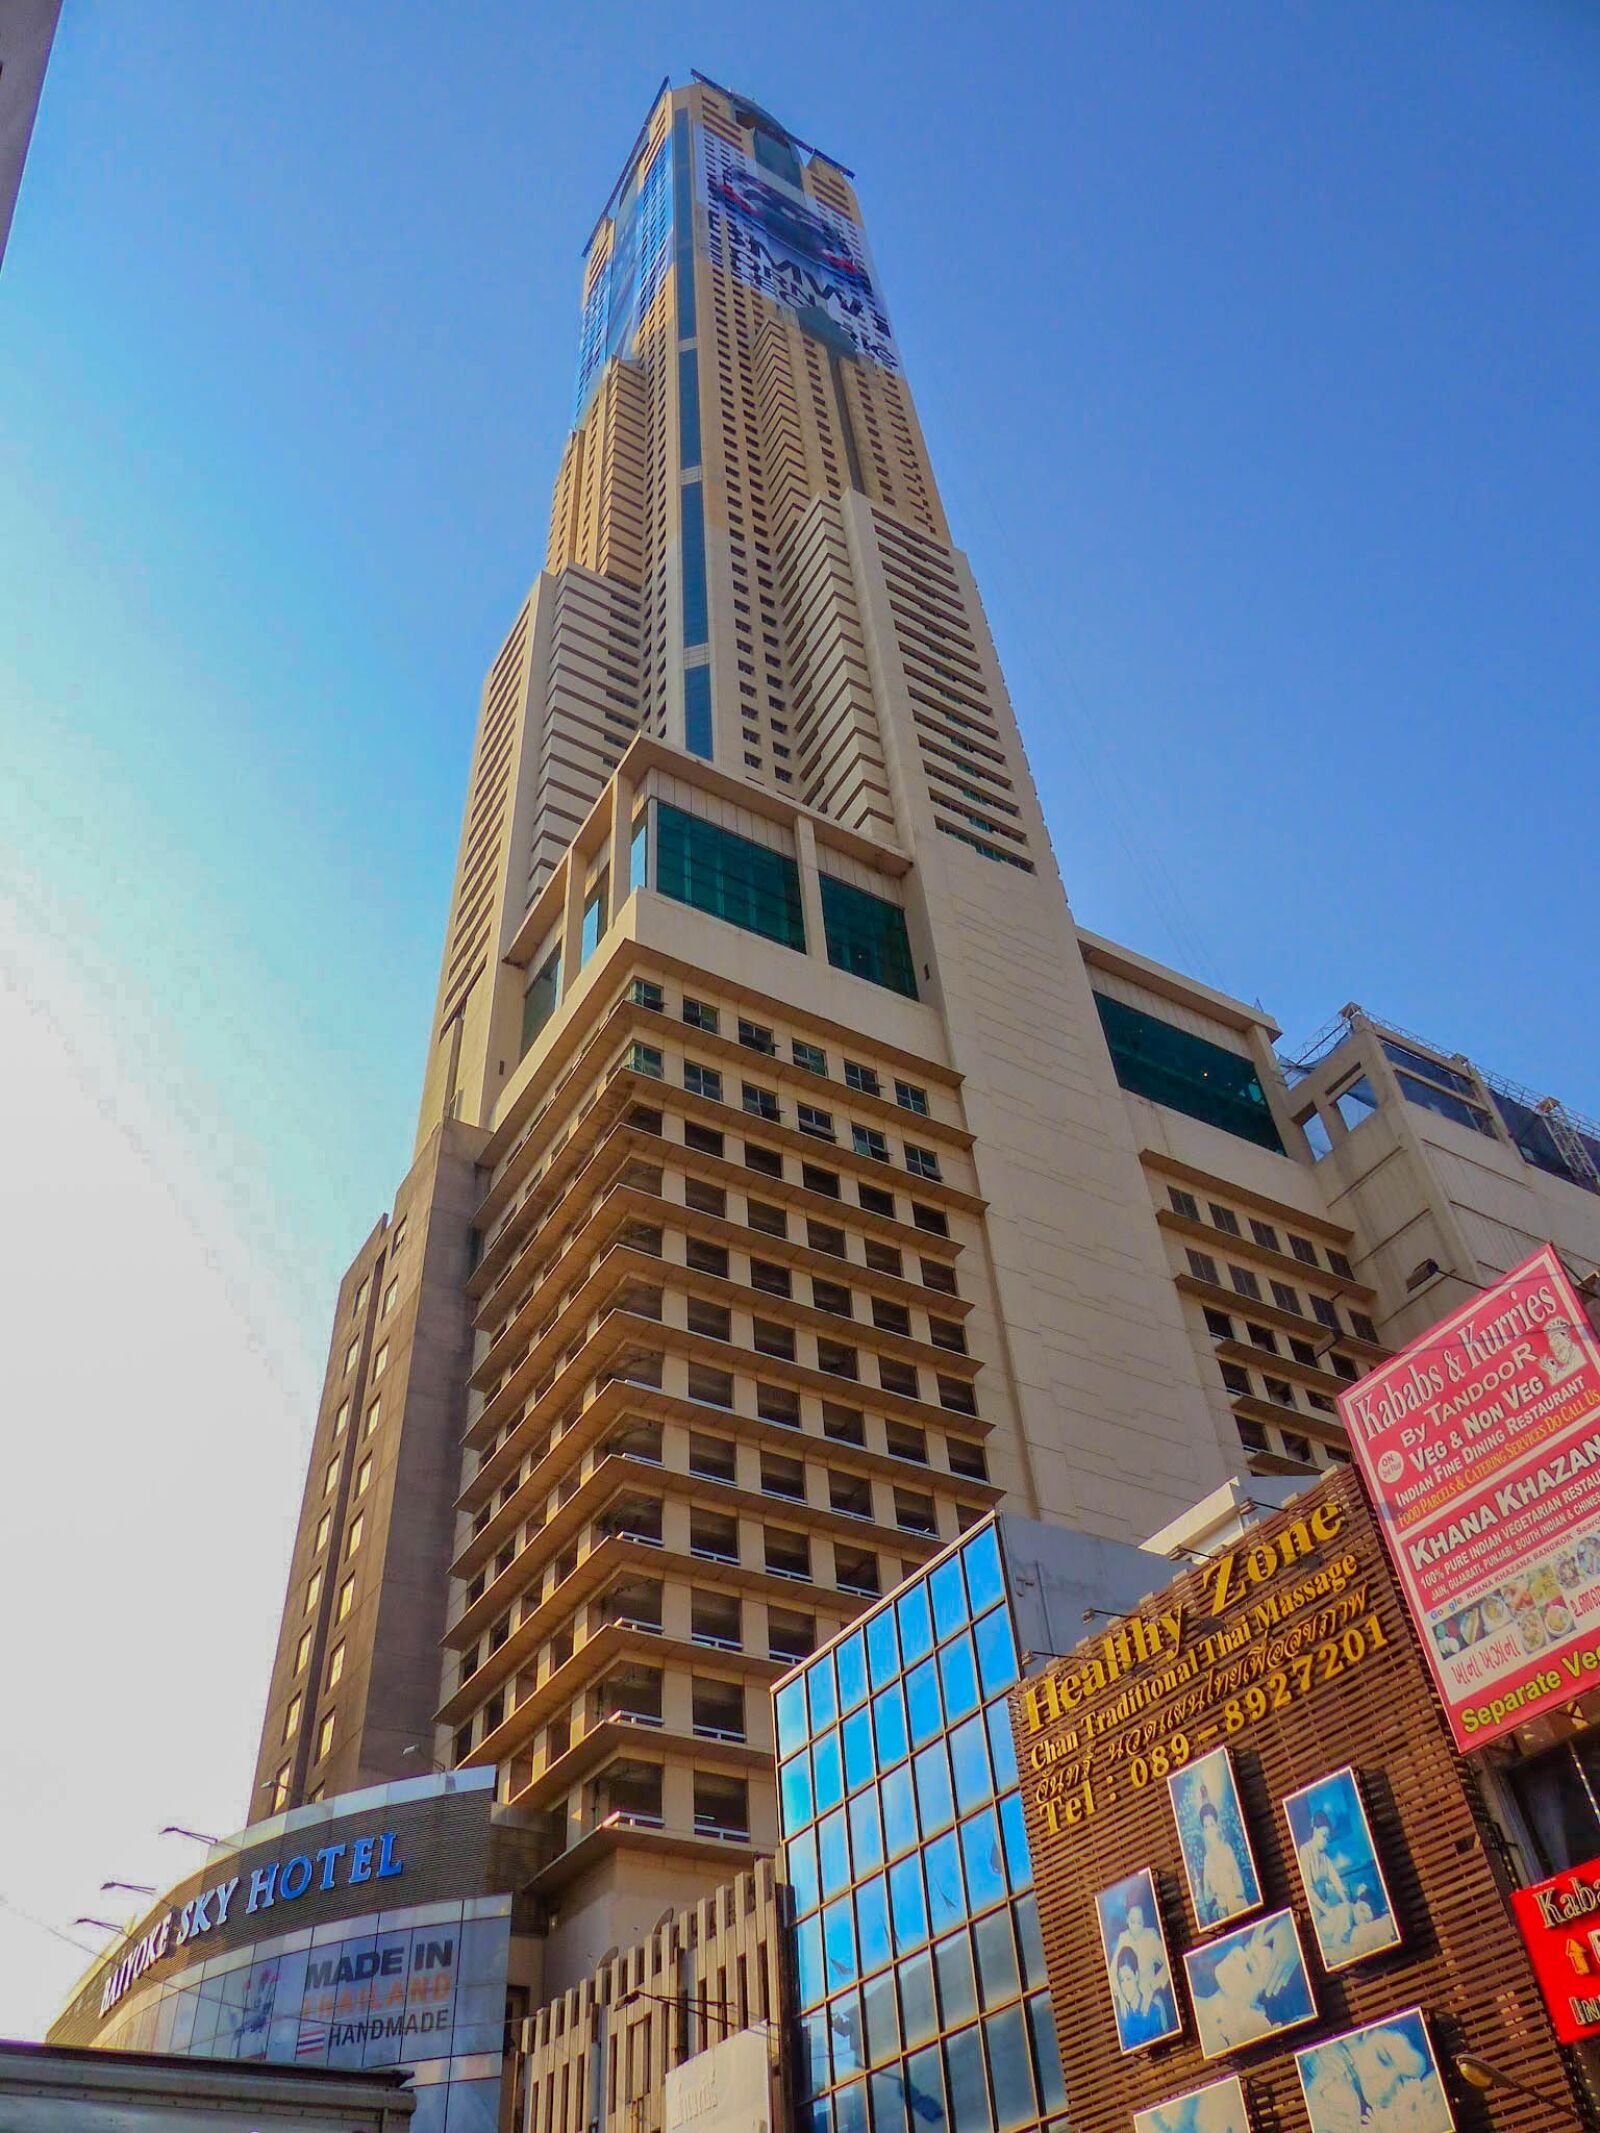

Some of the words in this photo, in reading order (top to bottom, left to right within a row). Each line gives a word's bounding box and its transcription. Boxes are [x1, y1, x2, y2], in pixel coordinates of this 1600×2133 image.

[708, 210, 864, 316] BMW
[710, 247, 897, 367] ELECRIC
[1356, 1364, 1445, 1441] Kababs
[1444, 1350, 1466, 1383] &
[1457, 1286, 1557, 1369] Kurries
[1401, 1422, 1427, 1447] By
[1423, 1342, 1538, 1427] TANDOOR
[1449, 1430, 1463, 1449] &
[1455, 1475, 1466, 1490] &
[1407, 1504, 1498, 1571] KHANA
[1421, 1567, 1445, 1589] 100%
[1444, 1552, 1470, 1576] PURE
[1469, 1531, 1502, 1560] INDIAN
[1501, 1496, 1562, 1539] VEGETARIAN
[1430, 1598, 1464, 1619] Gogle
[1466, 1580, 1493, 1599] KHANA
[1576, 1514, 1600, 1536] Searc
[1515, 1528, 1541, 1550] SOUTH
[1540, 1512, 1567, 1536] INDIAN
[1566, 1508, 1574, 1520] &
[1023, 1602, 1183, 1735] Healthy
[1203, 1501, 1346, 1616] Zone
[1031, 1731, 1079, 1770] Chan
[1081, 1649, 1199, 1739] Traditional
[1200, 1615, 1252, 1665] Thai
[1254, 1554, 1357, 1632] Massage
[1461, 1670, 1562, 1733] Separate
[1040, 1780, 1096, 1835] Tel
[176, 1877, 241, 1945] SKY
[245, 1831, 404, 1915] HOTEL
[306, 1947, 404, 1991] MADE
[414, 1939, 453, 1971] IN
[329, 2008, 449, 2047] HANDMADE
